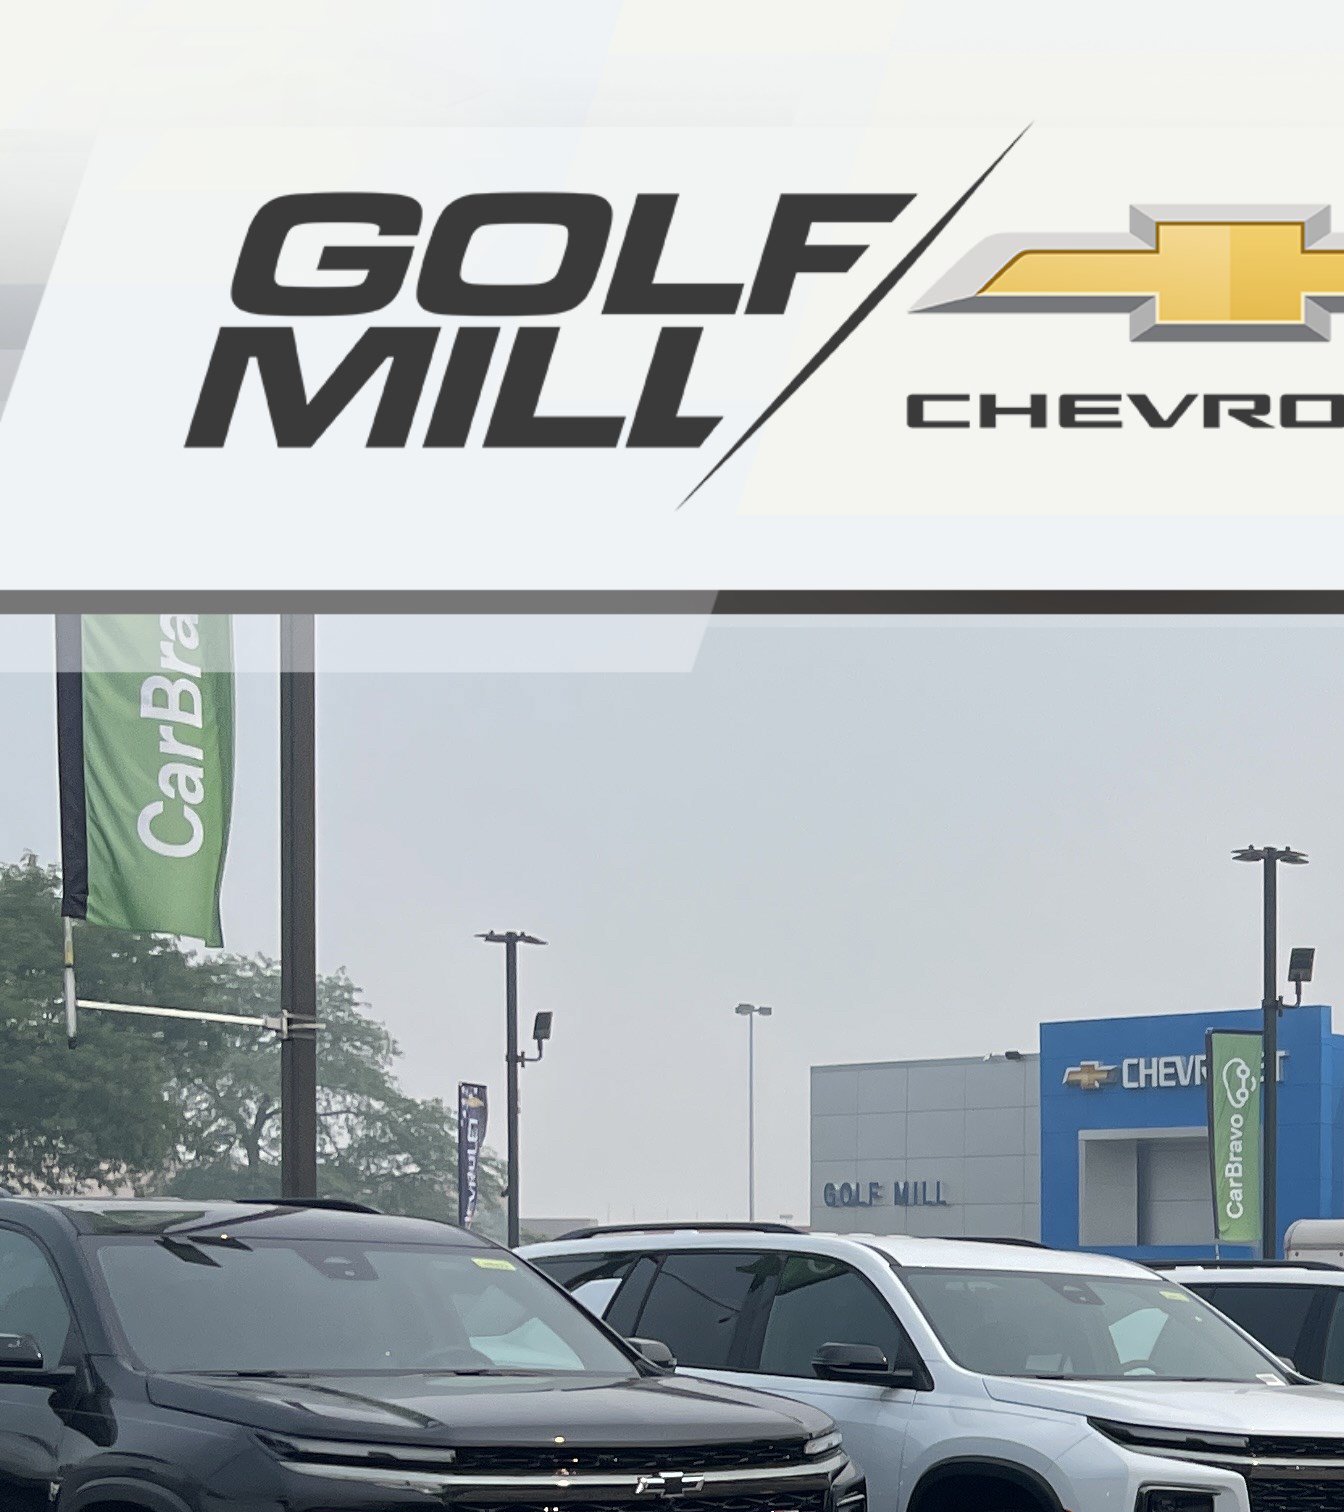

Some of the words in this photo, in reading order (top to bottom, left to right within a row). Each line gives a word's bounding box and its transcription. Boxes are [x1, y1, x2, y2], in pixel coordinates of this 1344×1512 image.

[137, 615, 204, 858] CarBra
[823, 1182, 883, 1208] GOLF
[893, 1180, 947, 1206] MILL
[1225, 1113, 1244, 1219] CarBravo
